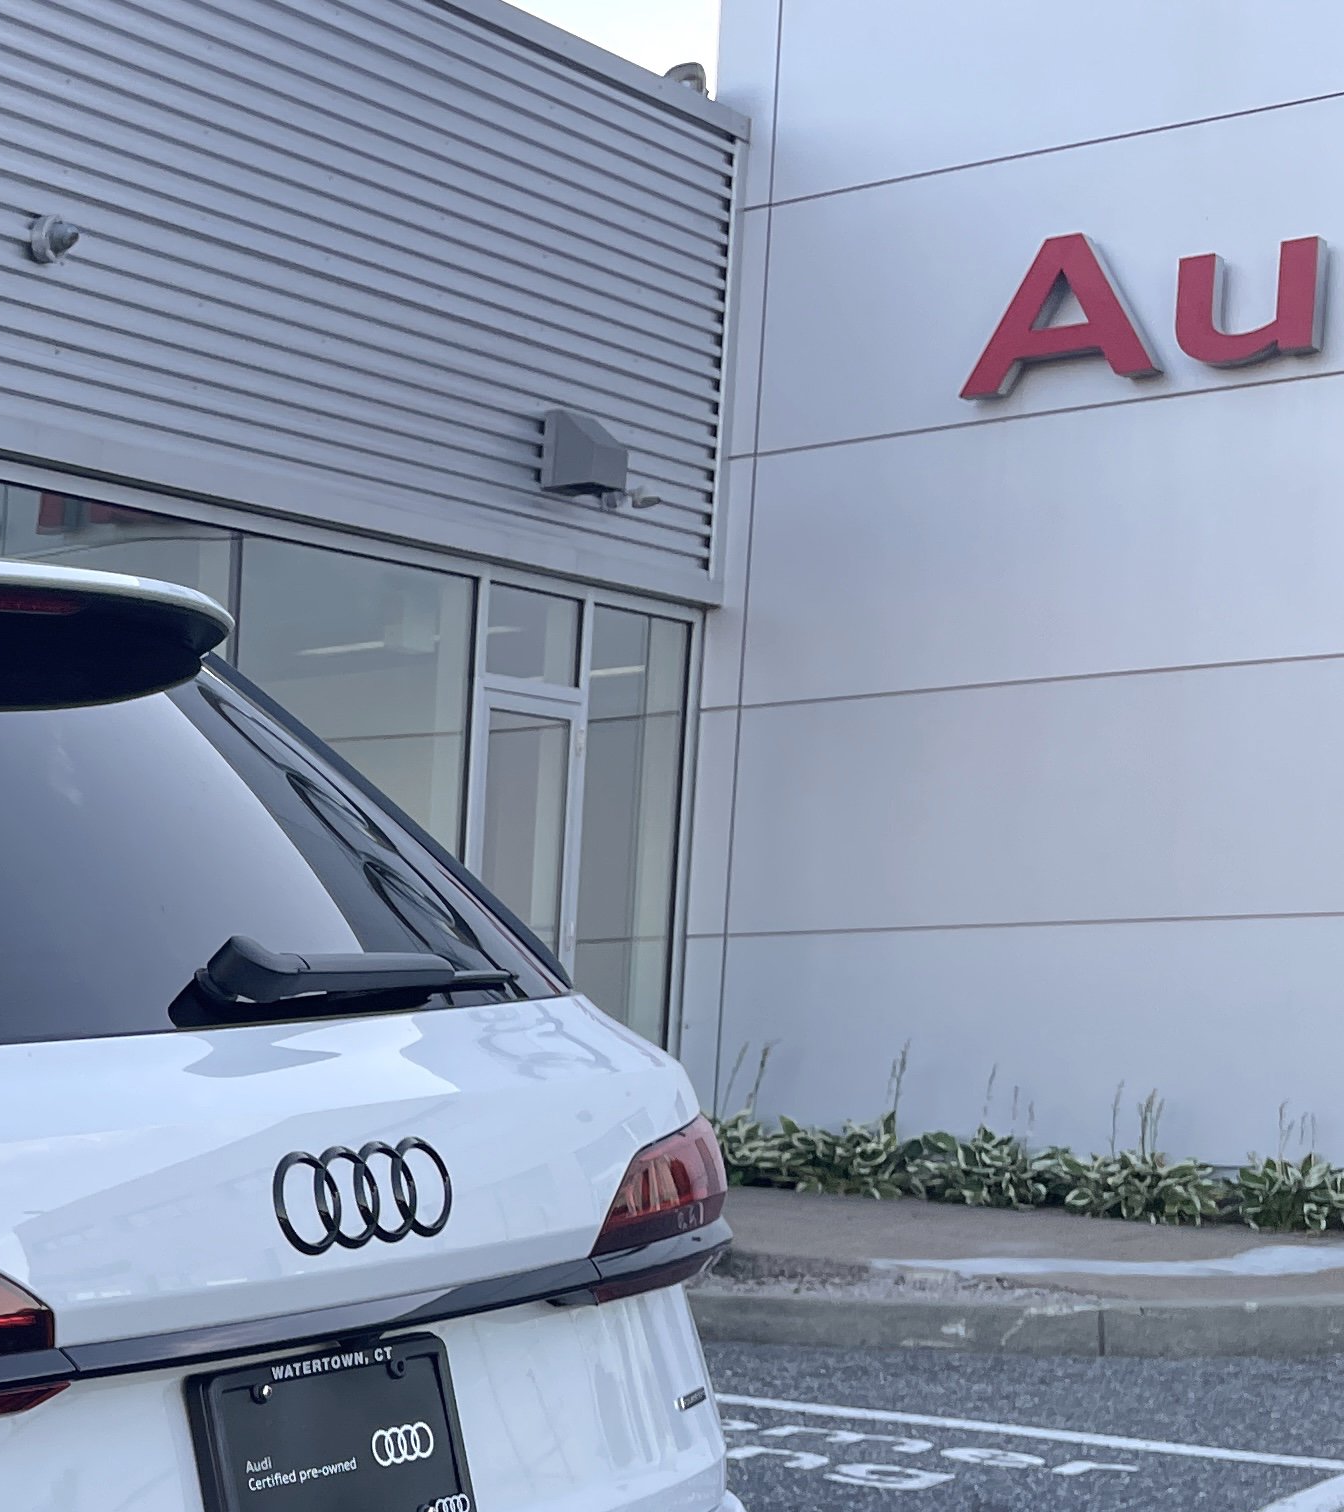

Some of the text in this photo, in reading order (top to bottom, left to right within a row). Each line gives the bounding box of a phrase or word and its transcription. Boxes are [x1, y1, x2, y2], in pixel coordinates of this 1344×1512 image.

[959, 231, 1326, 401] Au
[271, 1346, 393, 1381] WATERTOWN, CT
[246, 1456, 273, 1474] Audi
[248, 1457, 358, 1491] Certified pre-owned
